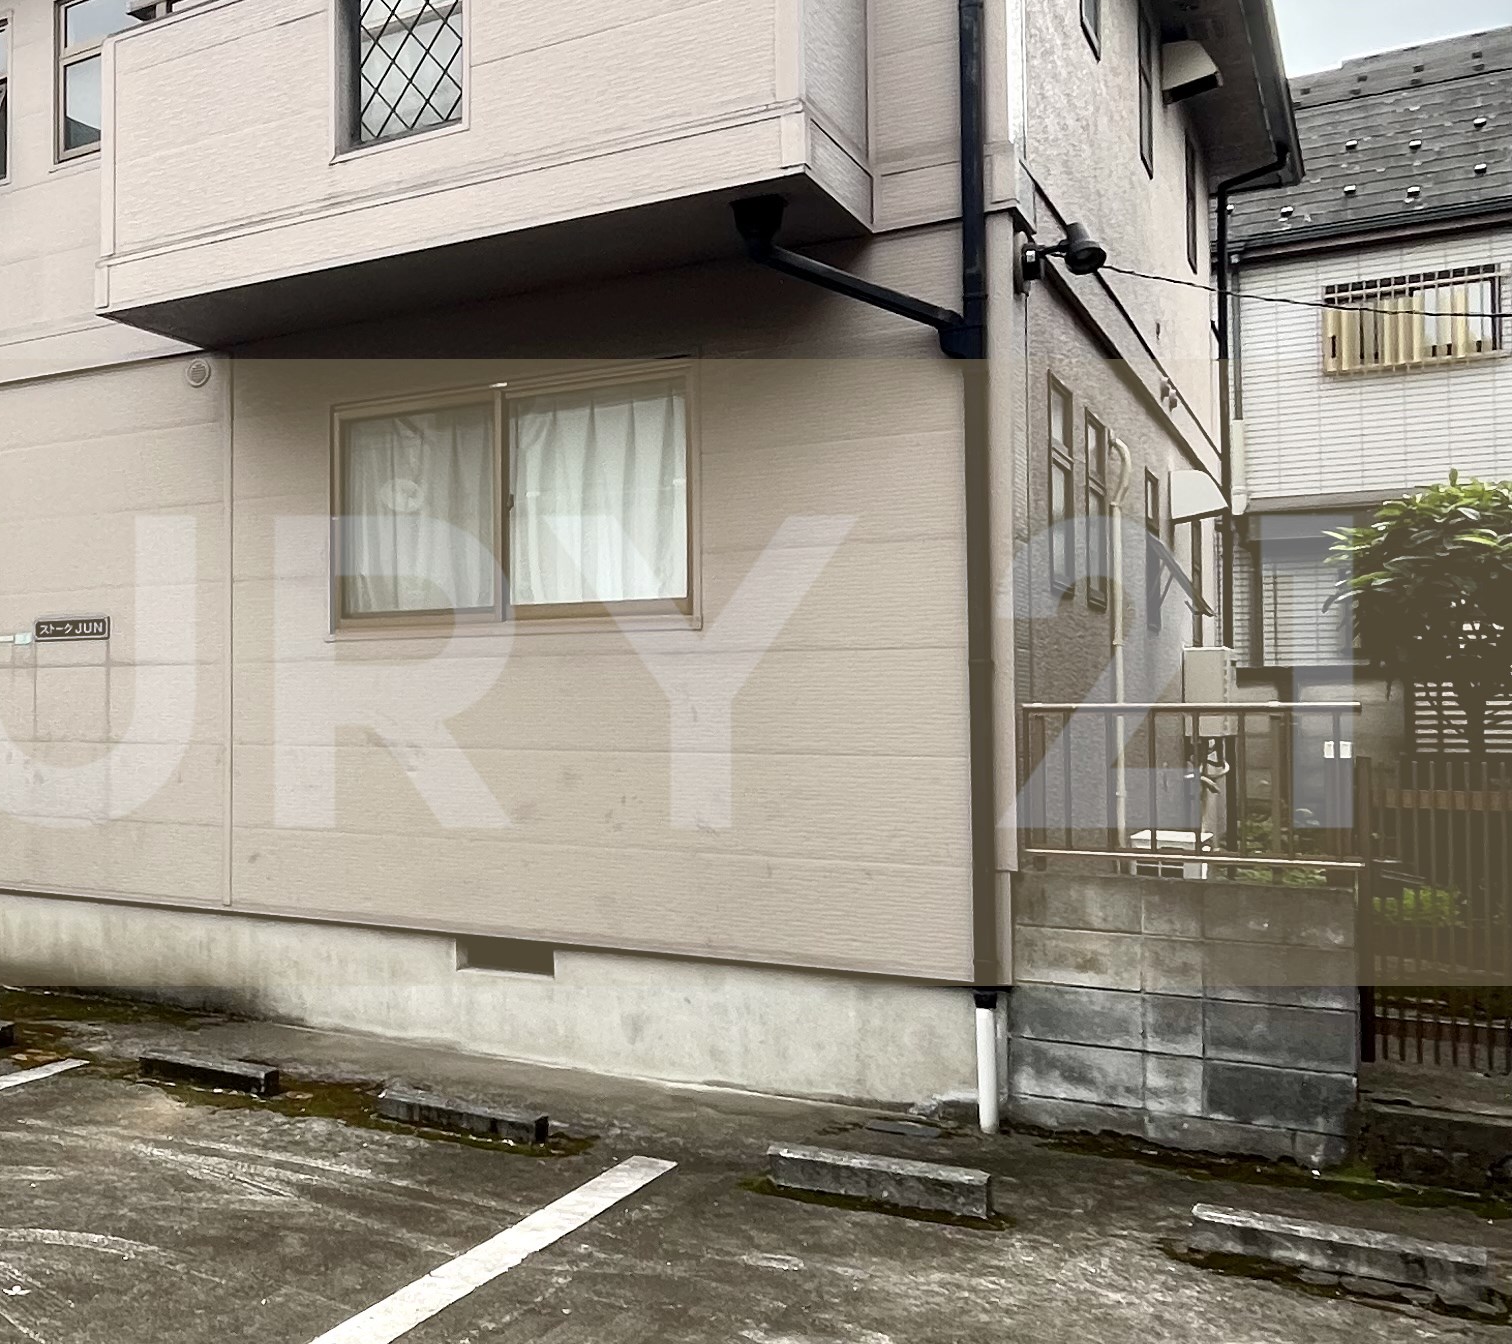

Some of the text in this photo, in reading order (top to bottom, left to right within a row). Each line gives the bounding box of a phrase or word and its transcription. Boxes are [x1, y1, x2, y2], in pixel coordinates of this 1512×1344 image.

[39, 622, 103, 635] ストーク JUN
